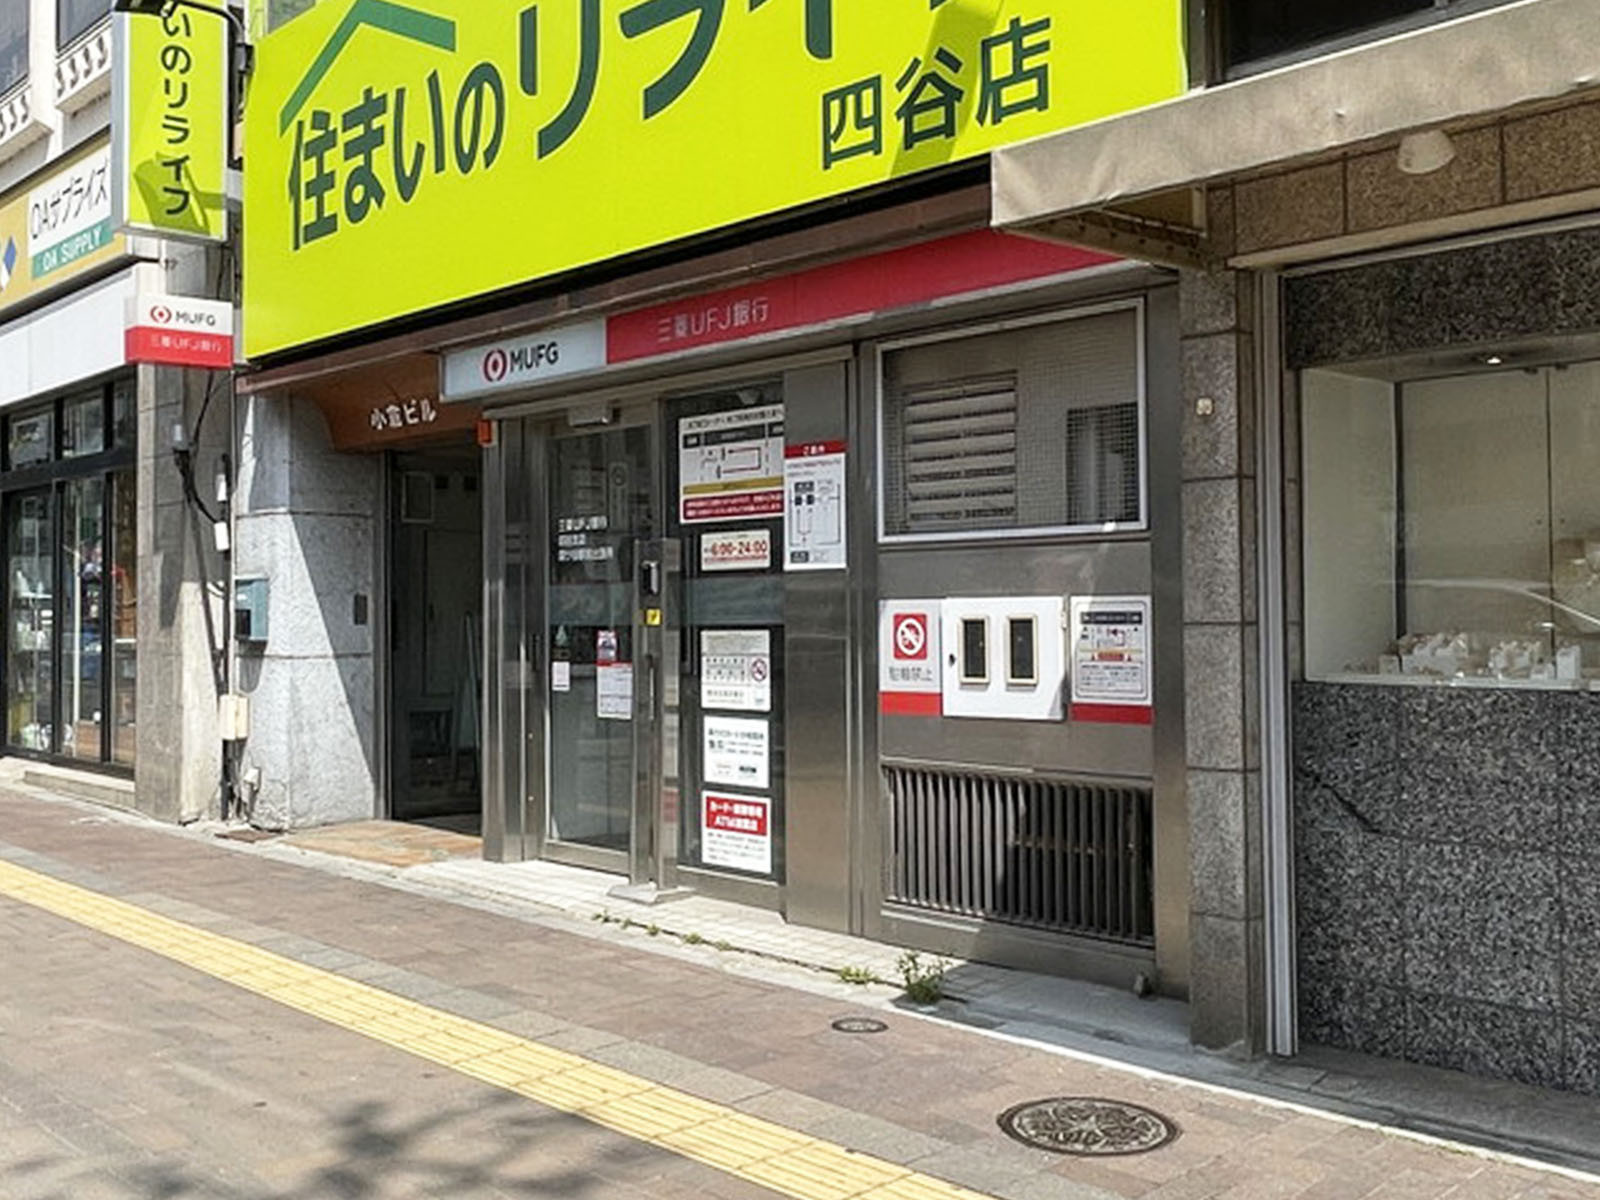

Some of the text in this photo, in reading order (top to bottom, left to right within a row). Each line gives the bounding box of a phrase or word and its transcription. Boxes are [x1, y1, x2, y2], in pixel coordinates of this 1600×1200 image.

[822, 16, 1051, 171] 四谷店
[60, 224, 103, 264] SUPPLY
[175, 310, 216, 327] MUFG
[510, 341, 559, 372] MUFG
